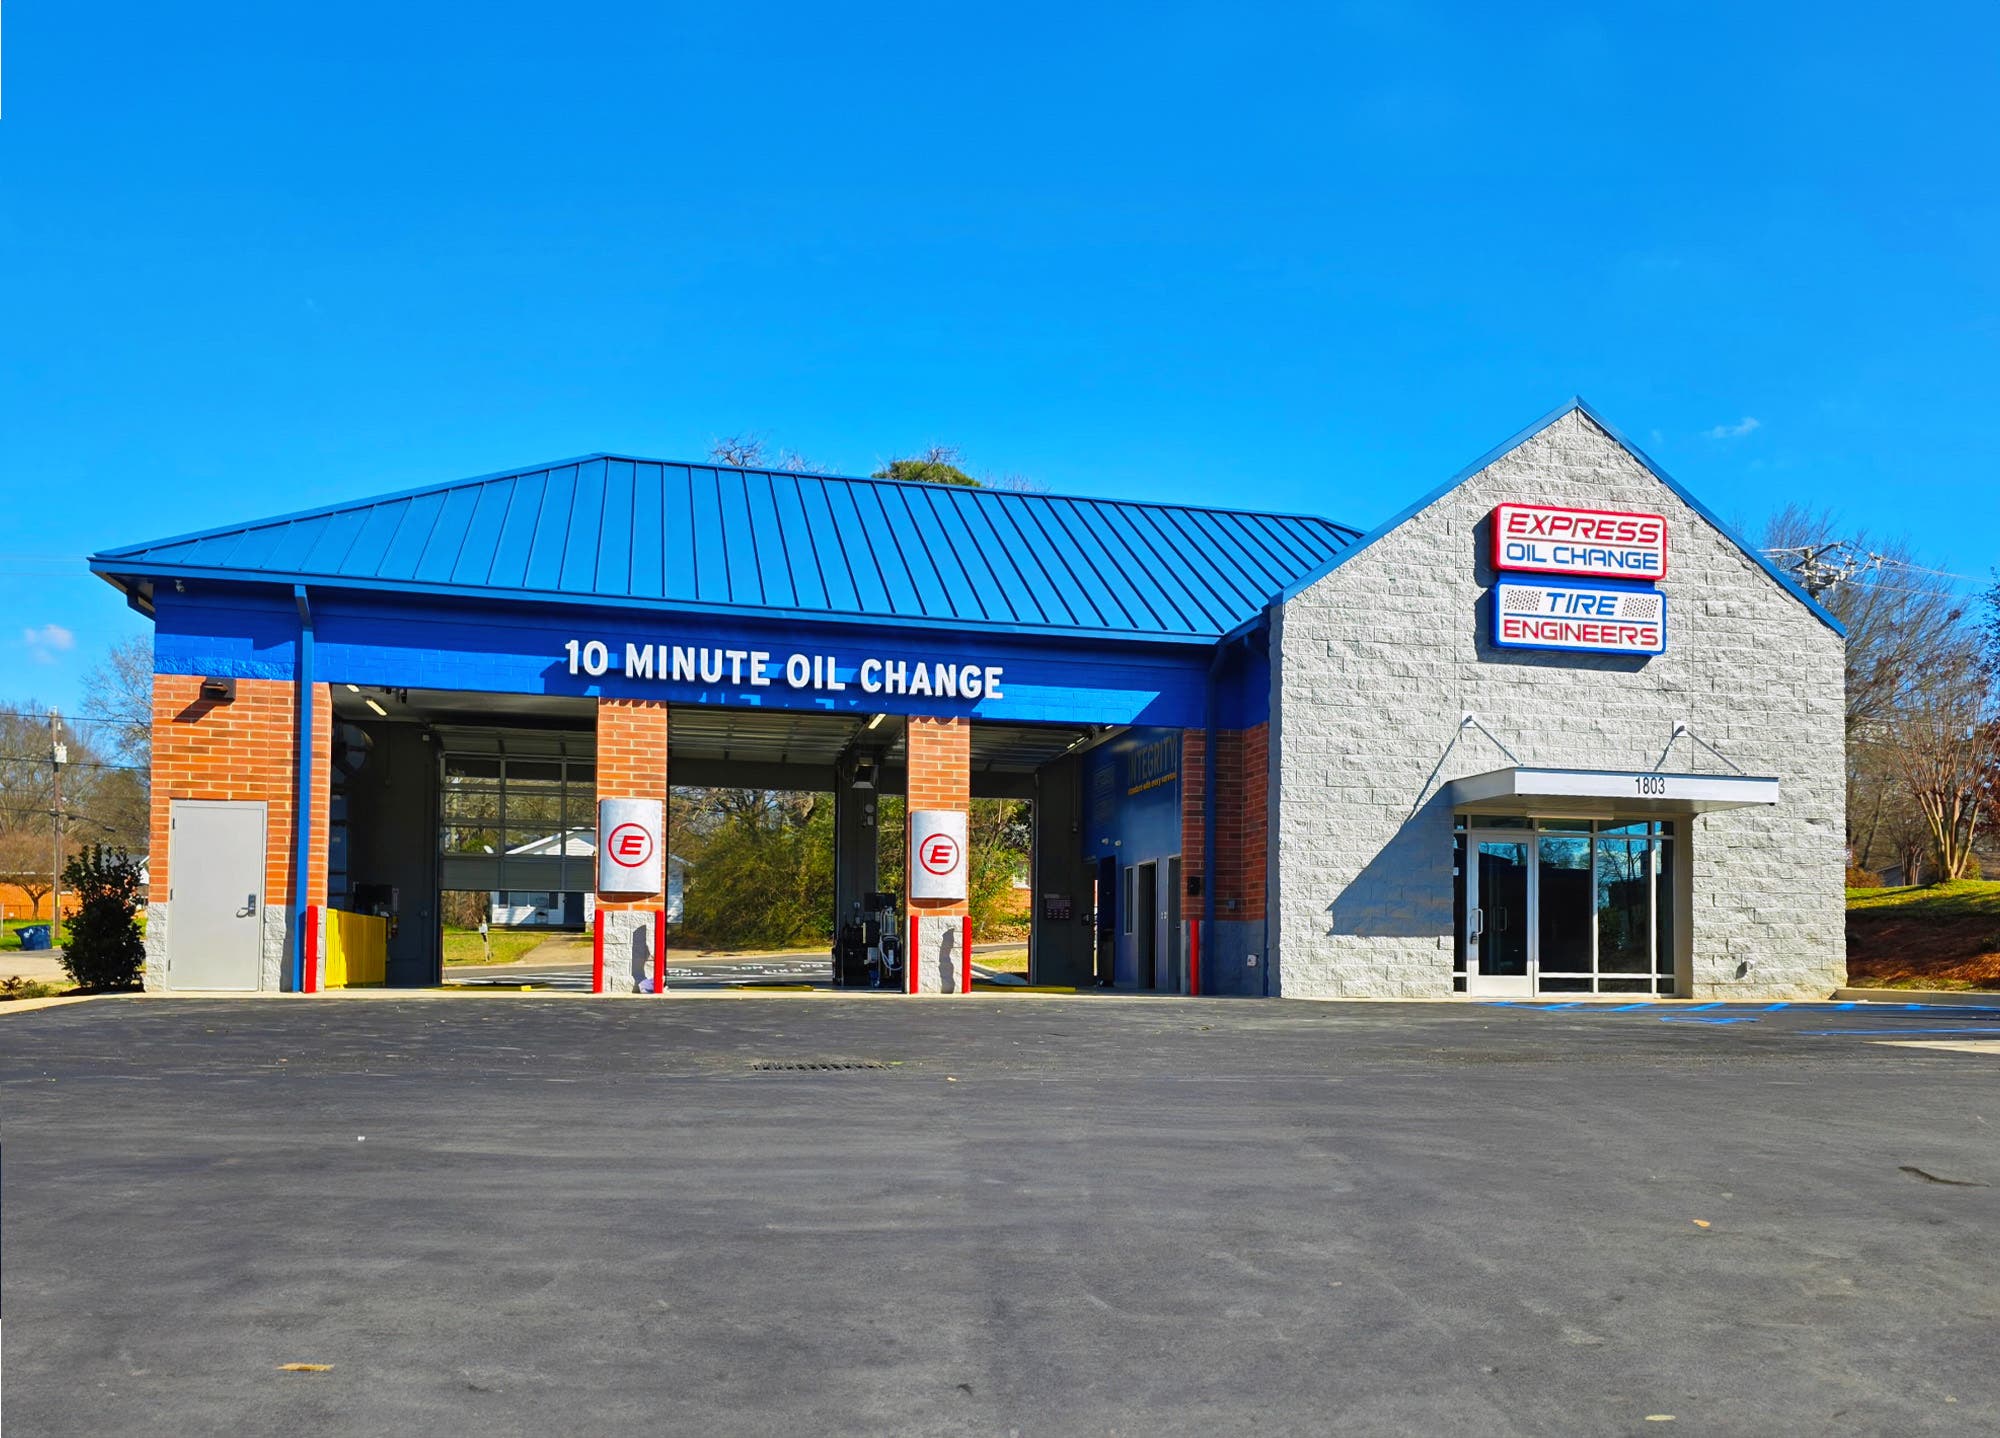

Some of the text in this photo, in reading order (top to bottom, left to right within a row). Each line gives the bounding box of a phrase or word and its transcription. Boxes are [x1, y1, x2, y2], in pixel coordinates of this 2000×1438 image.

[1507, 513, 1660, 542] EXPRESS
[1506, 543, 1659, 571] OIL CHANGE
[1546, 592, 1618, 616] TIRE
[1503, 619, 1658, 646] ENGINEERS
[565, 640, 1004, 699] 10 MINUTE OIL CHANGE
[1635, 776, 1665, 795] 1803
[619, 835, 645, 855] E
[930, 845, 953, 864] E
